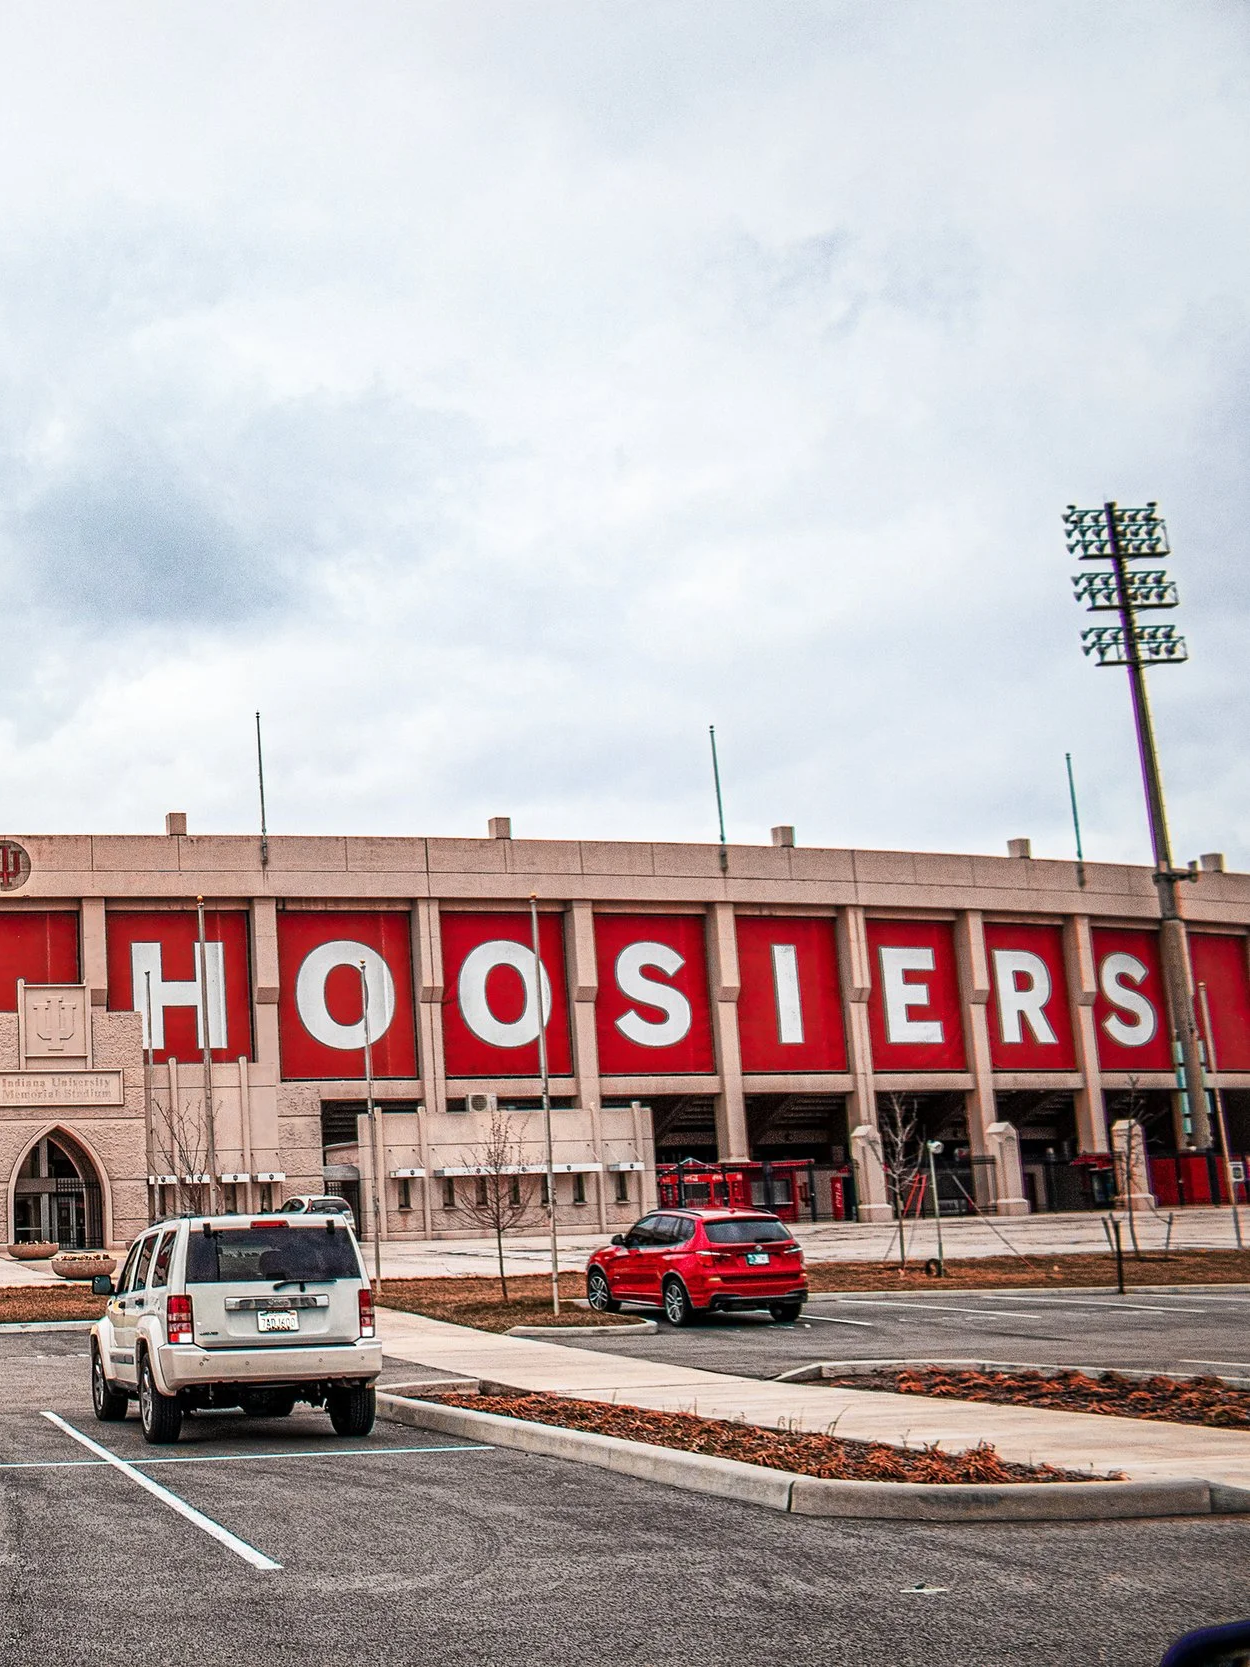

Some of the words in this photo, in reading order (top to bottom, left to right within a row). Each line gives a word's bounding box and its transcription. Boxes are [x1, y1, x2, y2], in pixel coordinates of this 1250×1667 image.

[130, 940, 1158, 1050] HOOSIERS
[2, 1078, 45, 1087] Indiana
[52, 1078, 110, 1088] University
[2, 1089, 58, 1099] Memorial
[65, 1089, 111, 1098] Stadium
